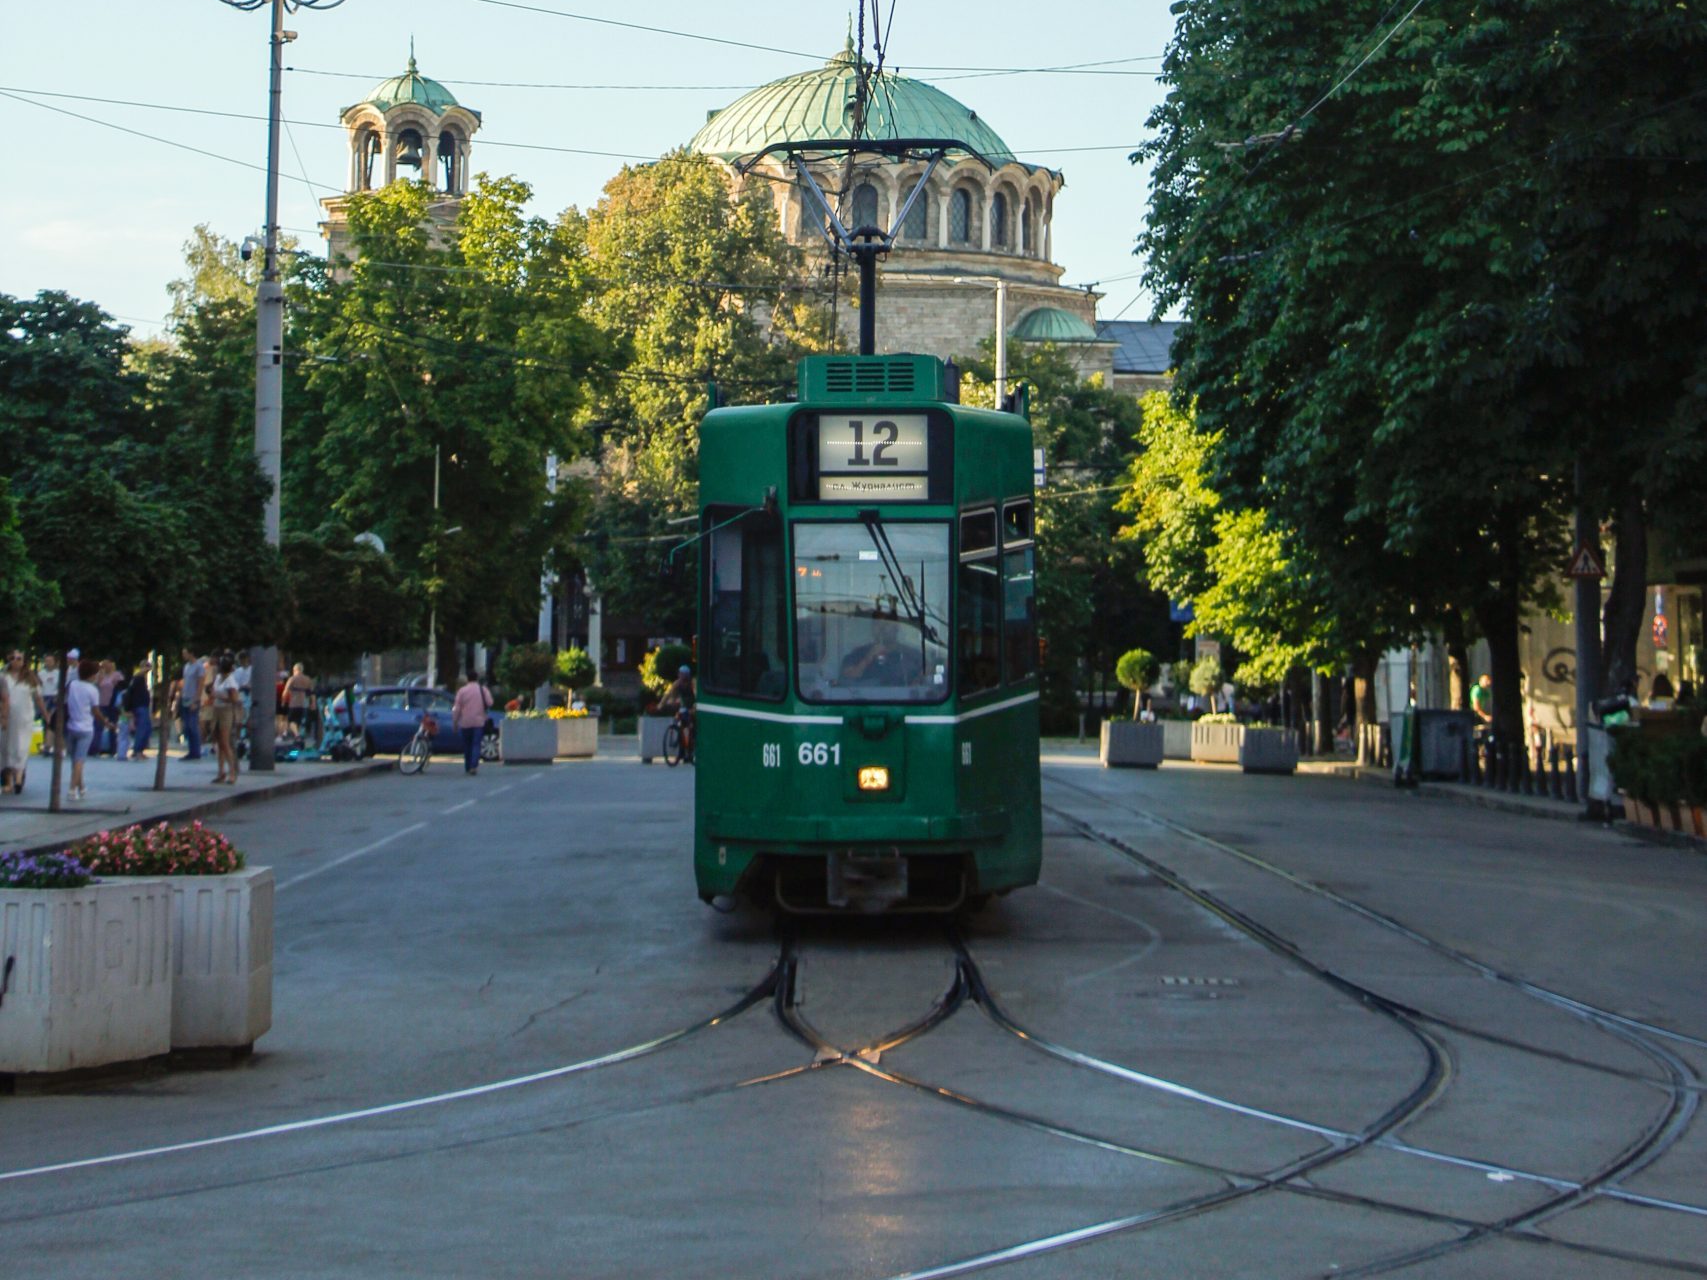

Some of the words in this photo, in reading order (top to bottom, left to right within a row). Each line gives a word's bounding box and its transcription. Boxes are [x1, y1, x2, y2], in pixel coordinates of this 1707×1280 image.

[847, 420, 899, 466] 12
[762, 743, 781, 767] 661
[798, 742, 840, 766] 661
